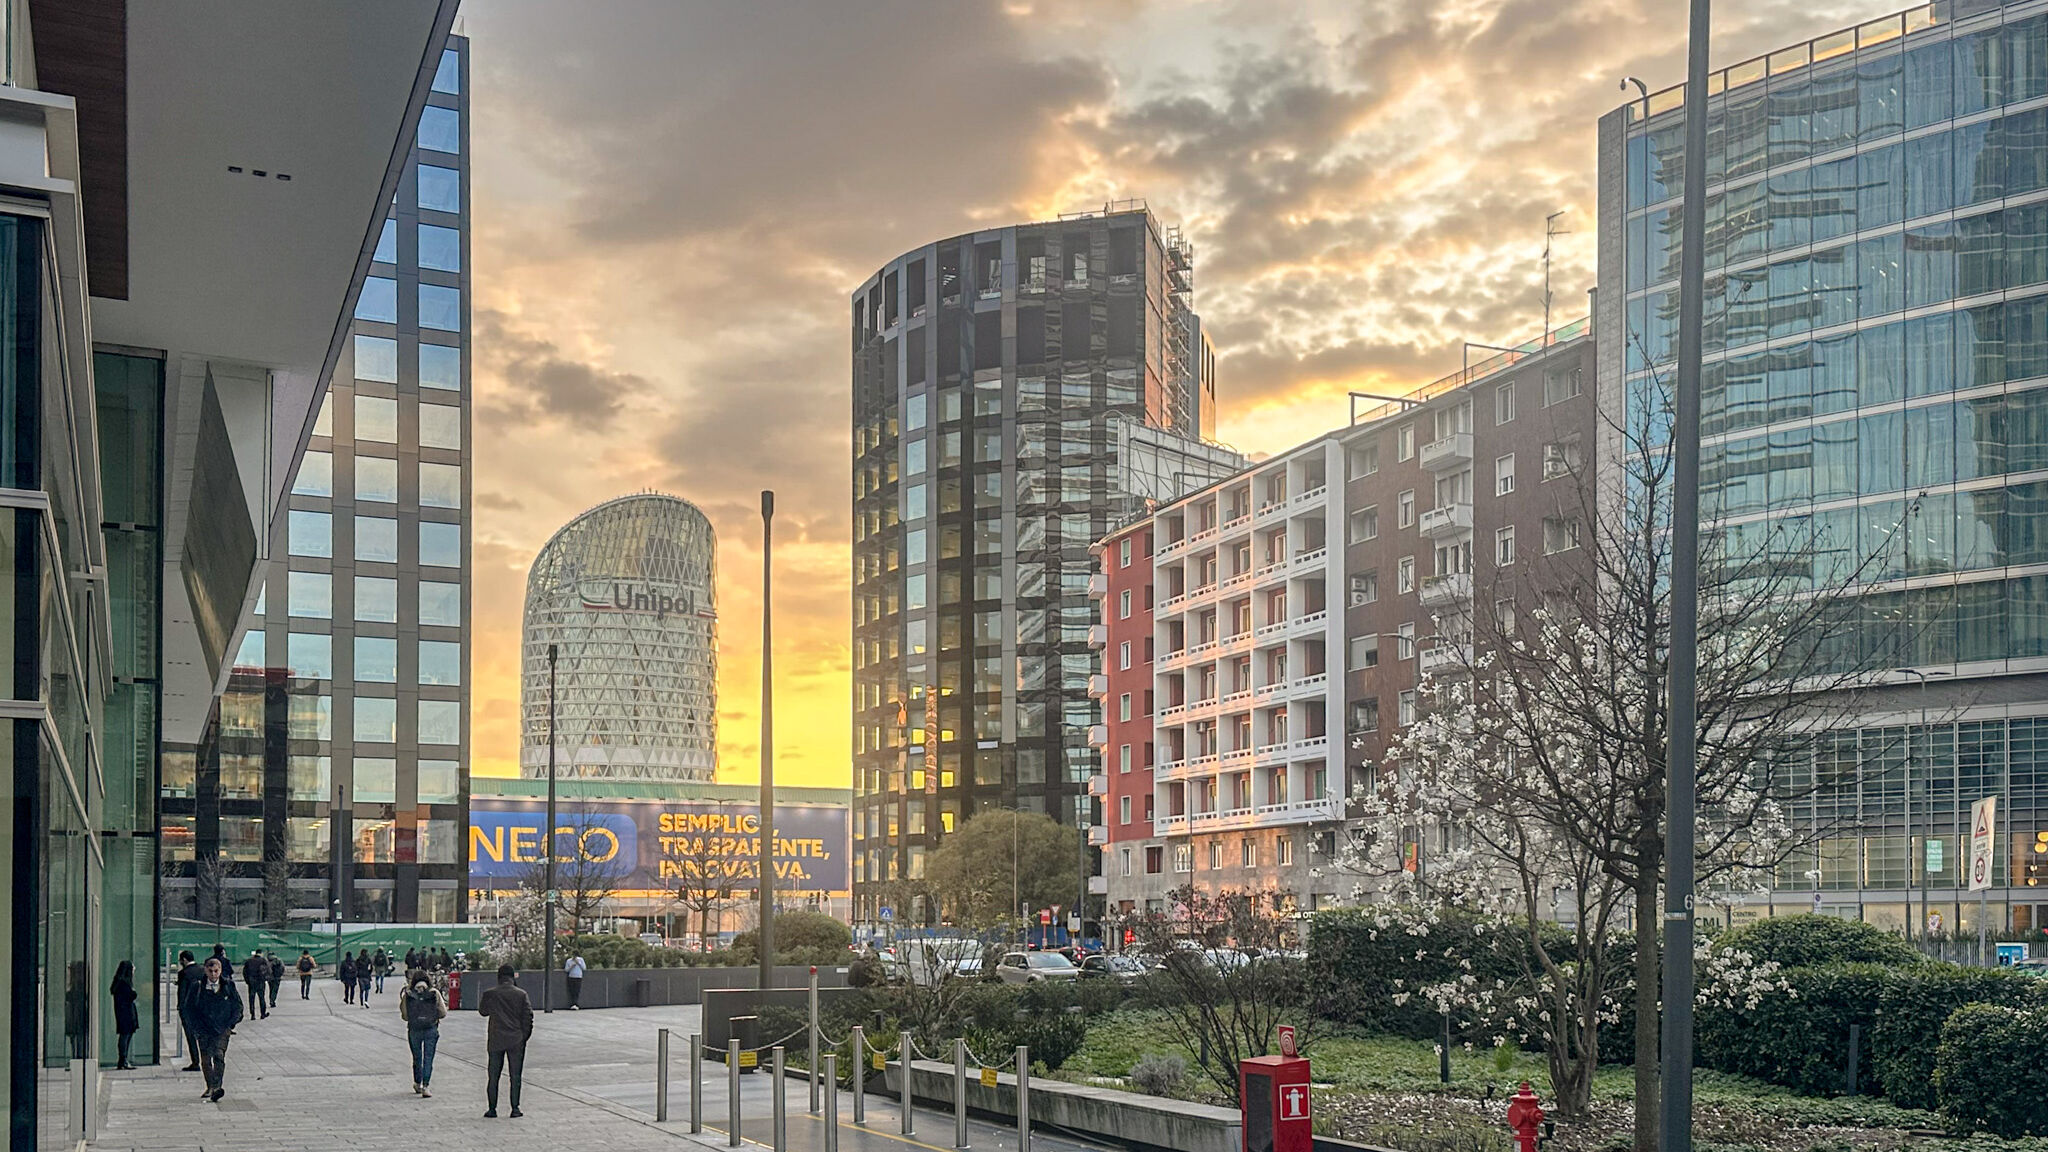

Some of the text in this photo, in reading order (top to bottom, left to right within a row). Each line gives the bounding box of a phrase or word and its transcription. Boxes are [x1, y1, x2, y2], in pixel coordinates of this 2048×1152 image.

[614, 583, 694, 620] Unipol
[658, 812, 779, 836] SEMPLIC,
[469, 826, 619, 863] NECO
[658, 859, 811, 880] INNOVATVA.
[1684, 894, 1694, 910] 6
[1693, 917, 1723, 929] CML
